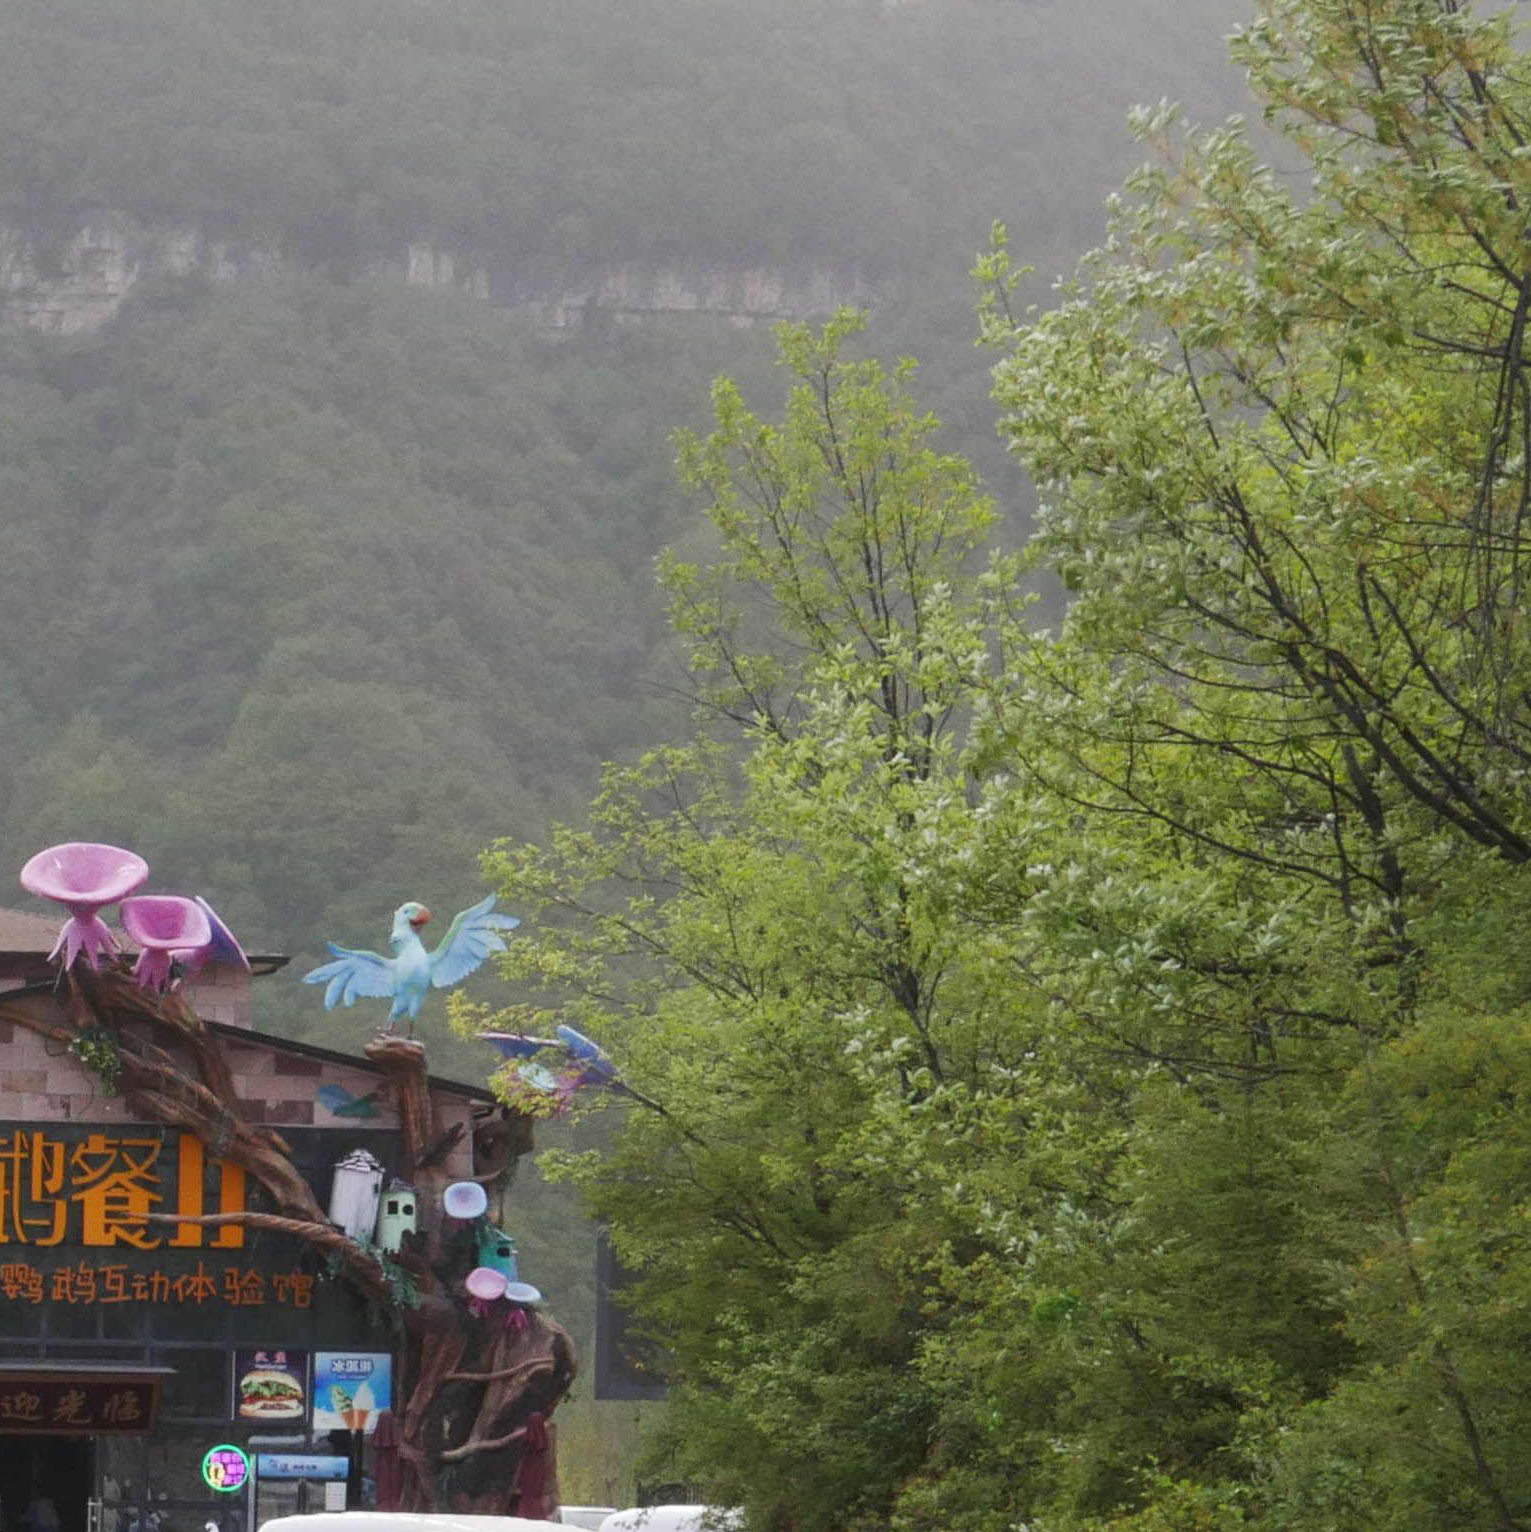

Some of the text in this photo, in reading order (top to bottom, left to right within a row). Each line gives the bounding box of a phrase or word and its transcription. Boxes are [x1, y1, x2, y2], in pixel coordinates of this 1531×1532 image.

[0, 1261, 315, 1309] 鹦鹉互动体验馆
[331, 1358, 372, 1374] 冰淇淋
